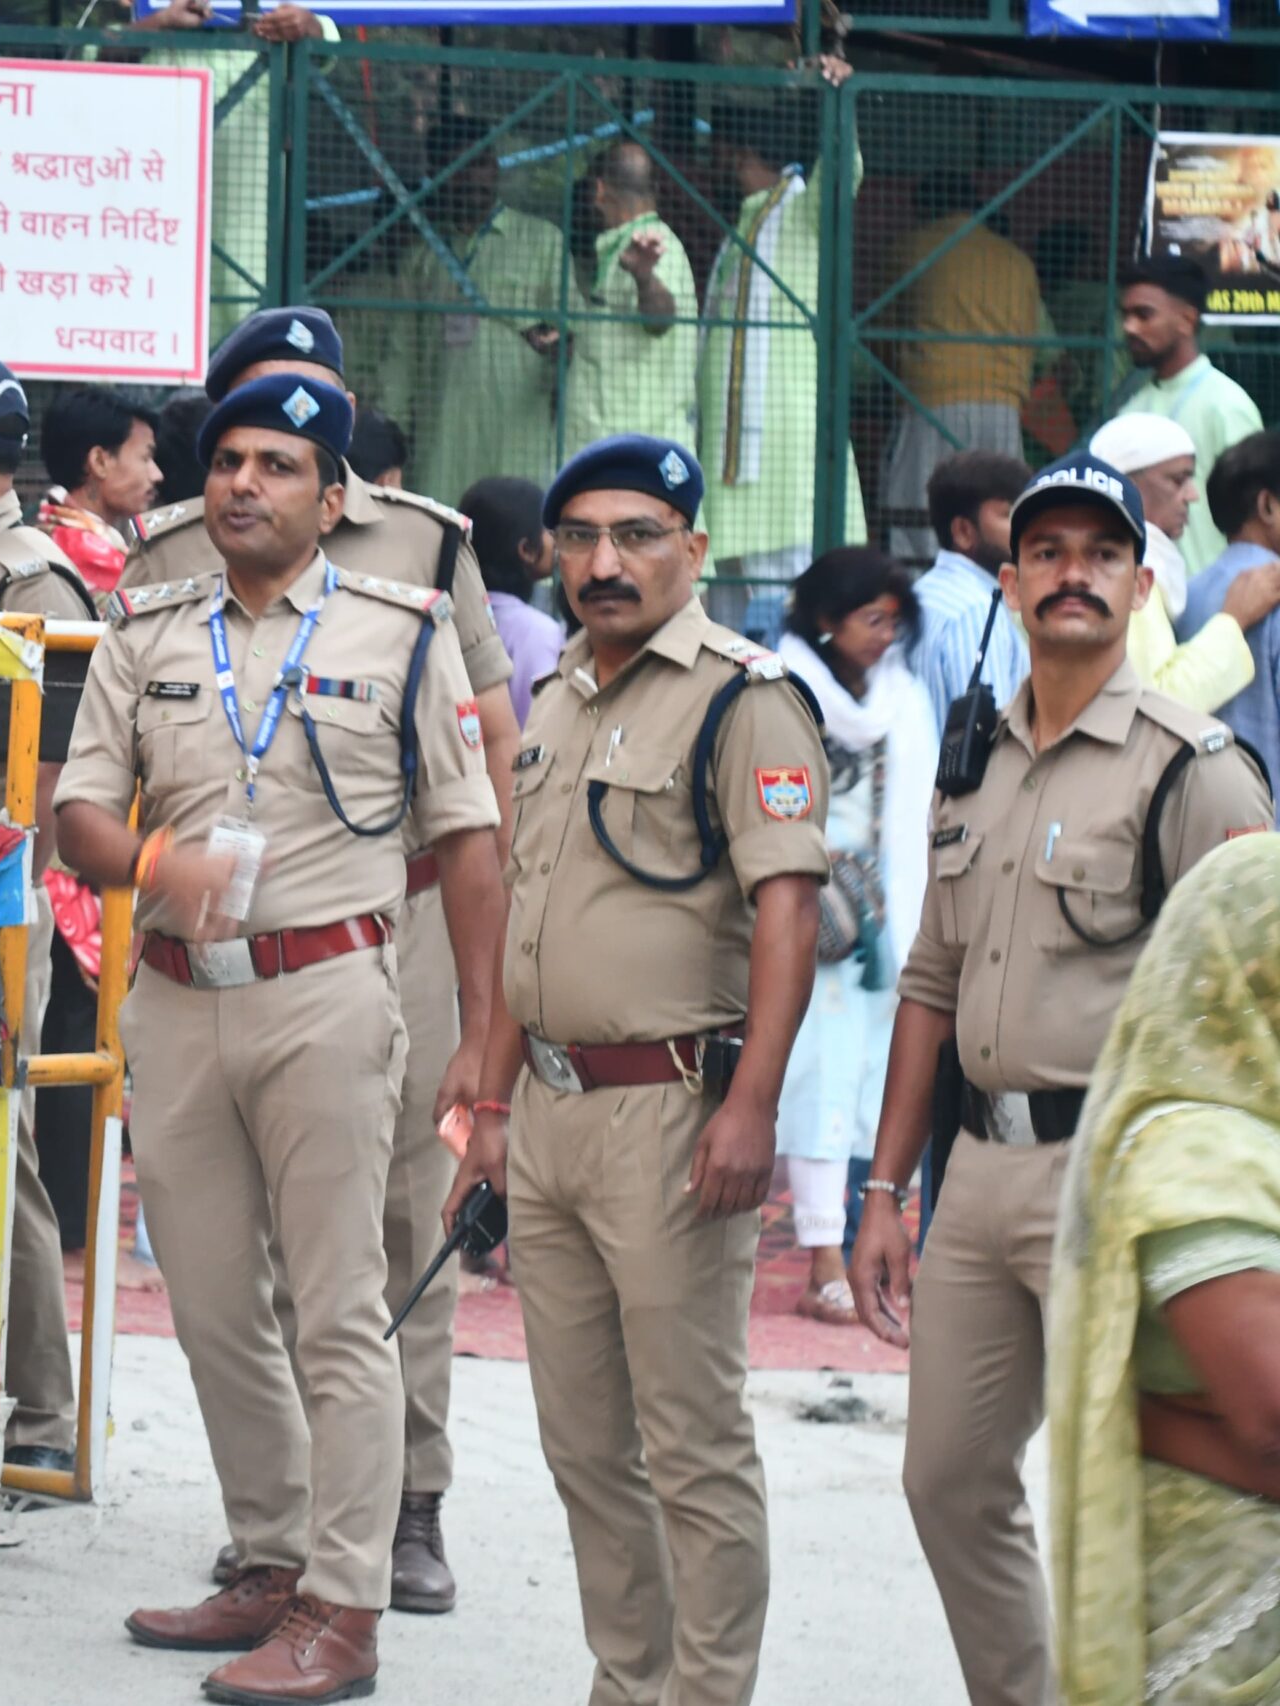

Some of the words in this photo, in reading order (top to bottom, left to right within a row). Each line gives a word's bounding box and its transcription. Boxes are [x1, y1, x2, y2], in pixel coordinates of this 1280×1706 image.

[140, 149, 165, 182] से
[21, 209, 91, 239] वाहन
[19, 269, 78, 302] खड़ा
[55, 325, 157, 356] धन्यवाद
